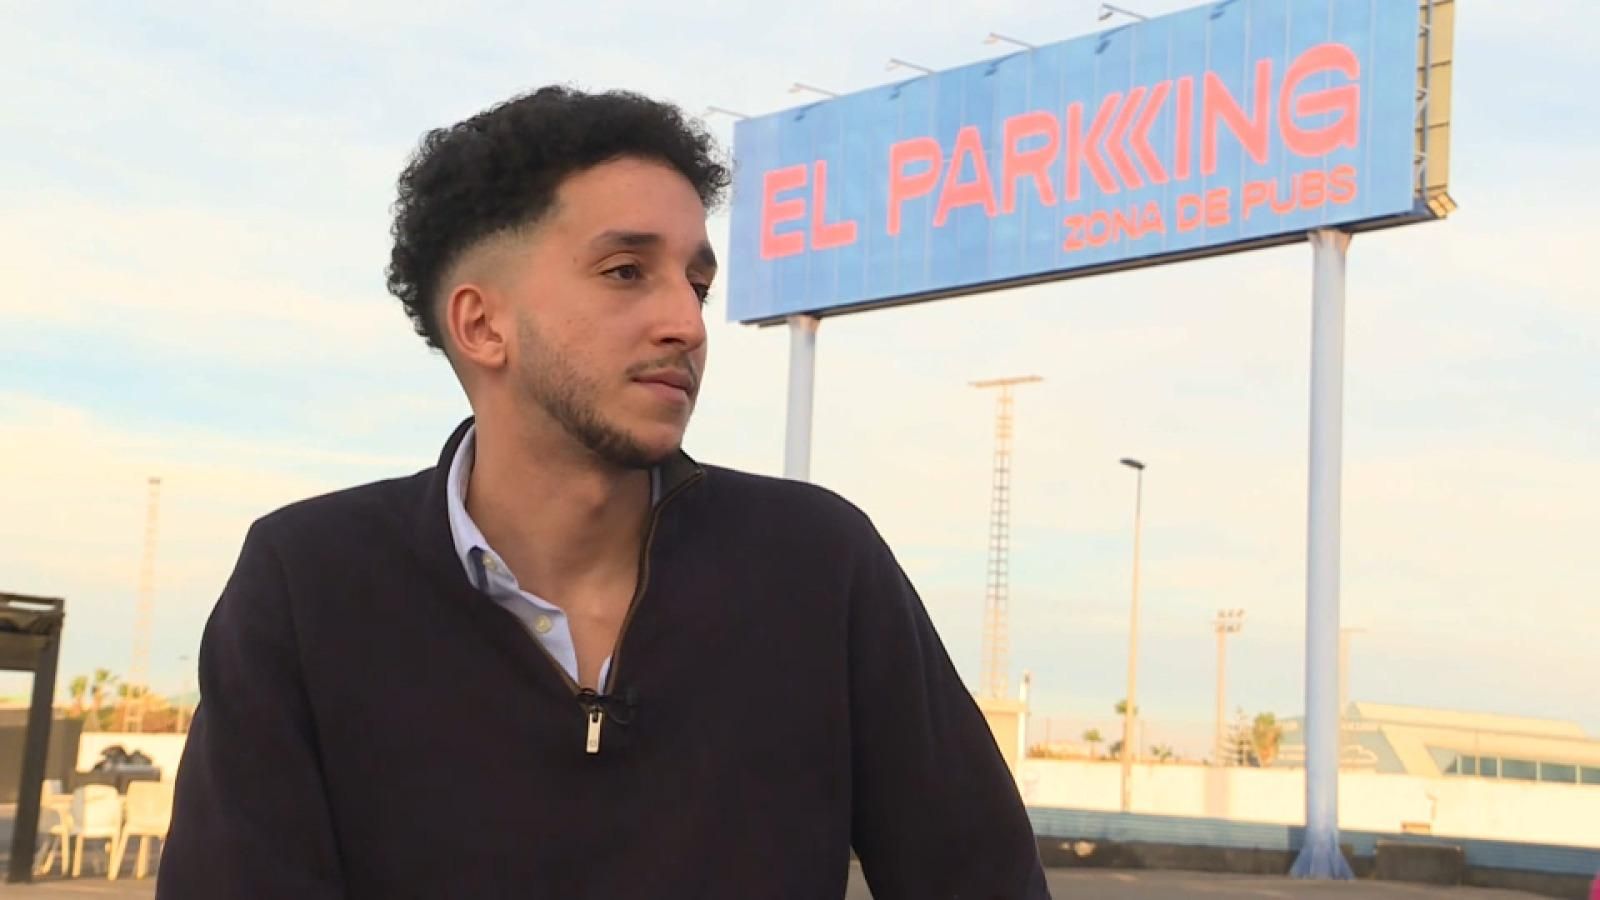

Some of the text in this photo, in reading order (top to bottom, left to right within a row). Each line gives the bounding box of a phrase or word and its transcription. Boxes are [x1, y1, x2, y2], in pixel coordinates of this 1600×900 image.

[759, 159, 857, 262] EL
[1062, 164, 1359, 253] ZONA DE PUBS
